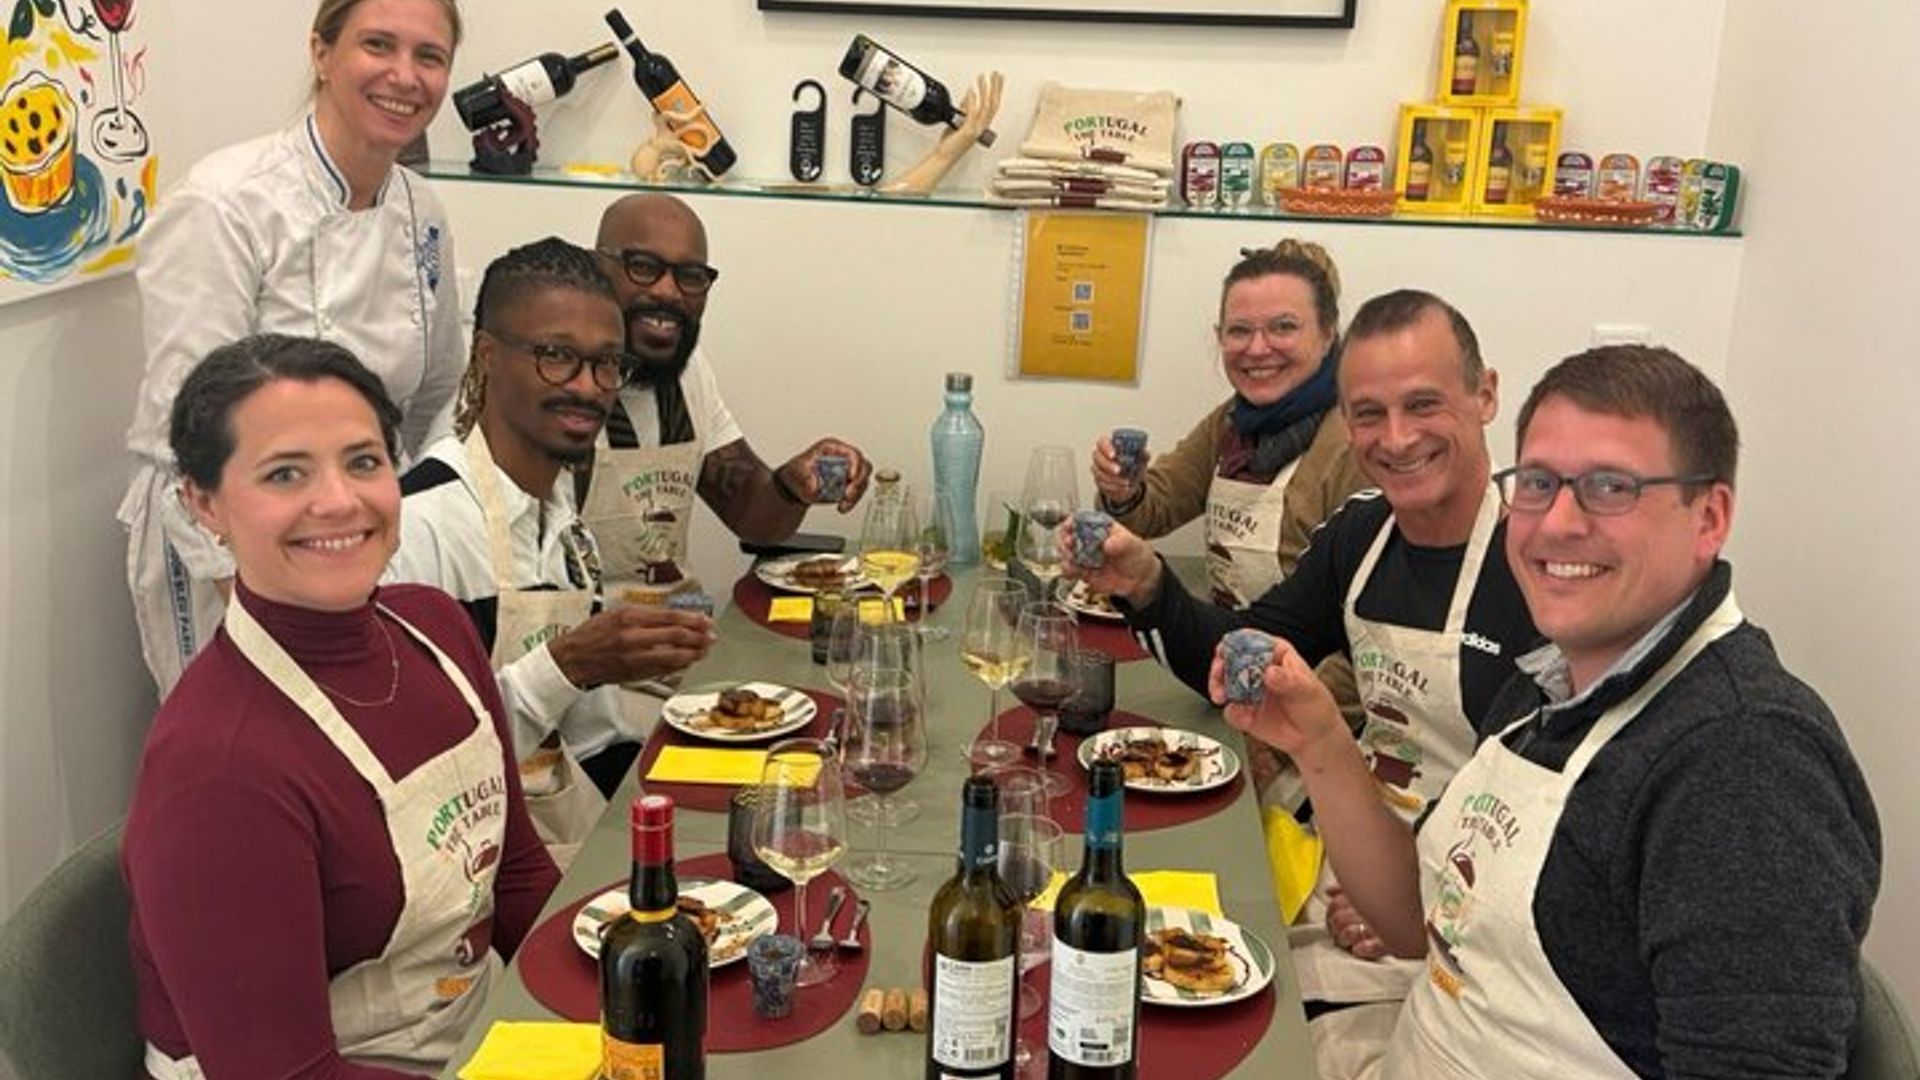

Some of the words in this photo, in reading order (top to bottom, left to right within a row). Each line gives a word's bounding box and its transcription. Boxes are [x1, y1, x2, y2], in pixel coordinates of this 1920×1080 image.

[1064, 116, 1147, 136] PORTUGAL
[1101, 130, 1136, 142] TABLE
[179, 616, 193, 656] PARIS
[1461, 632, 1501, 656] adidas
[426, 776, 505, 851] PORTUGAL
[461, 801, 501, 829] TABLE
